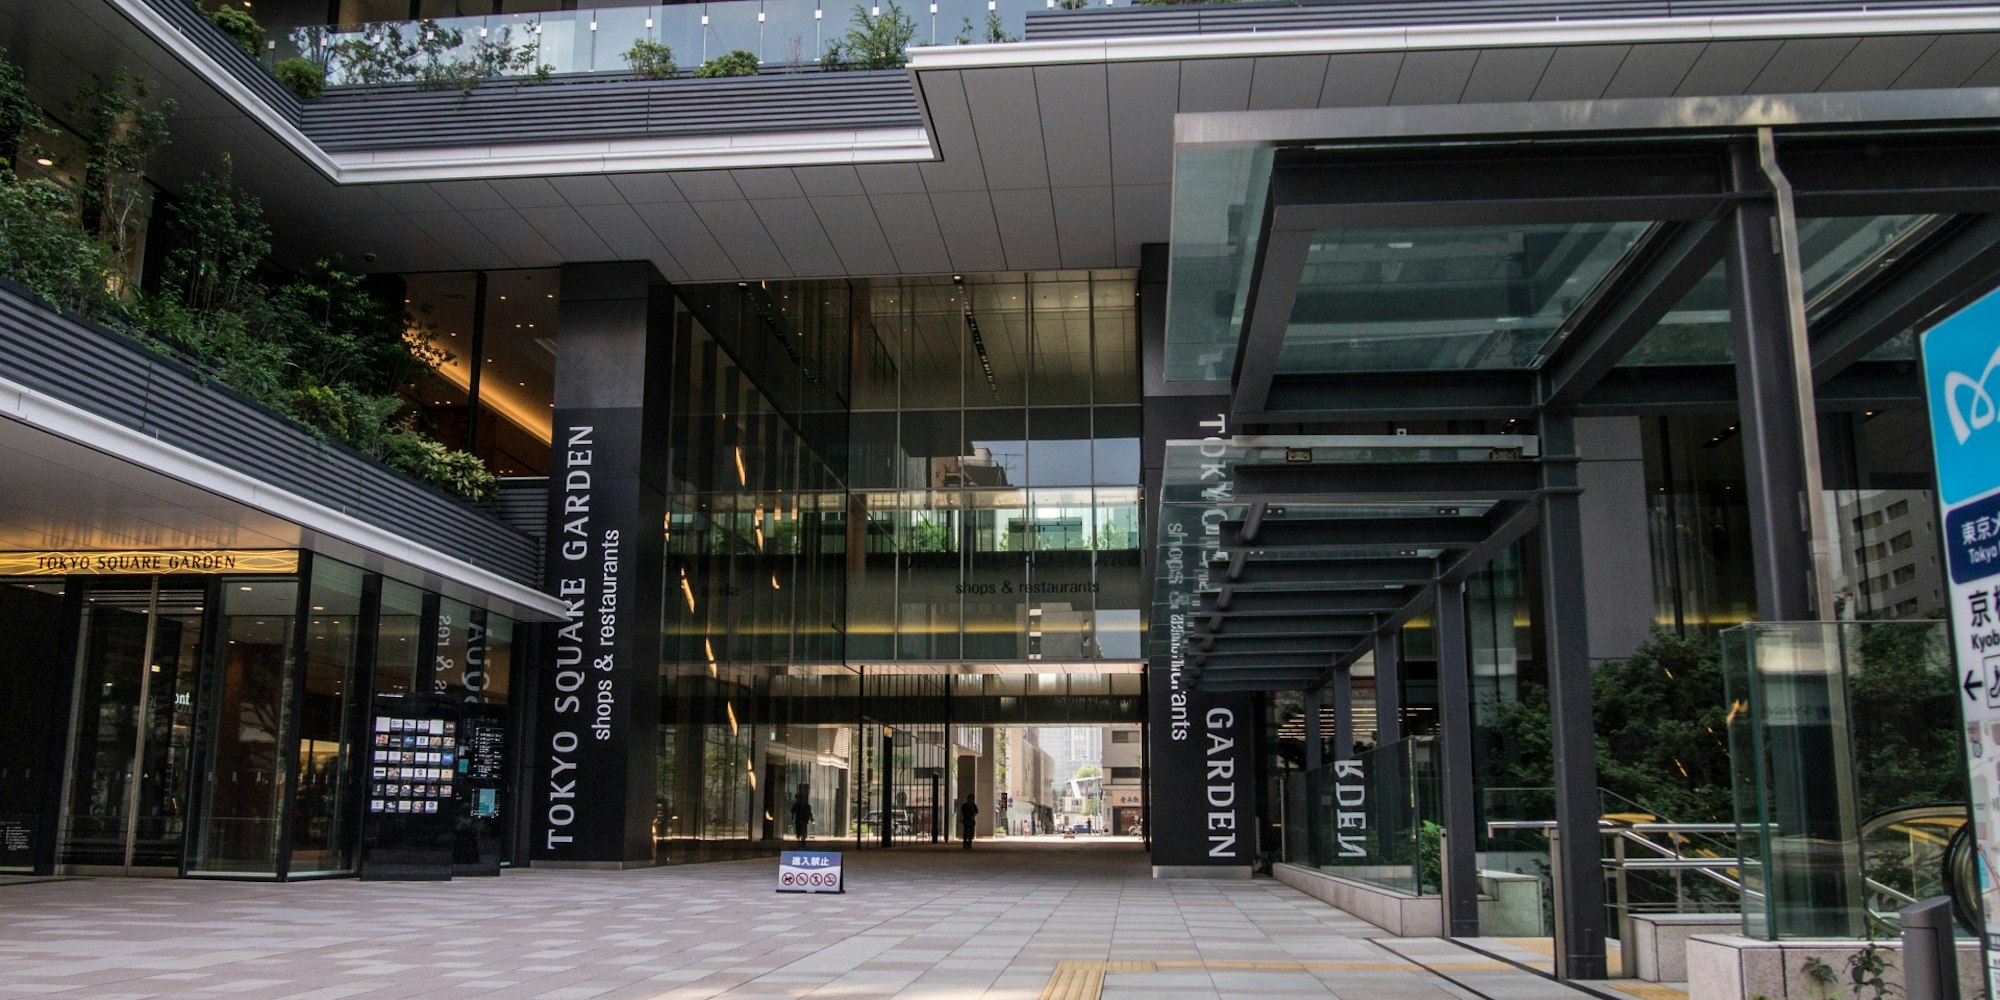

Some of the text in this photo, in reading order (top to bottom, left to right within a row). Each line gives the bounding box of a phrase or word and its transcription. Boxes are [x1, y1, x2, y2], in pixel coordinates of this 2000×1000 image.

[37, 556, 236, 570] TOKYO SQUARE GARDEN
[1968, 545, 1998, 564] Tokyo
[955, 580, 1100, 595] shops & restaurants
[547, 426, 594, 850] TOKYO SQUARE GARDEN
[591, 529, 620, 741] shops & restaurants
[1971, 629, 2000, 653] Kyob
[1206, 707, 1236, 857] GARDEN
[791, 856, 830, 866] 進入禁止
